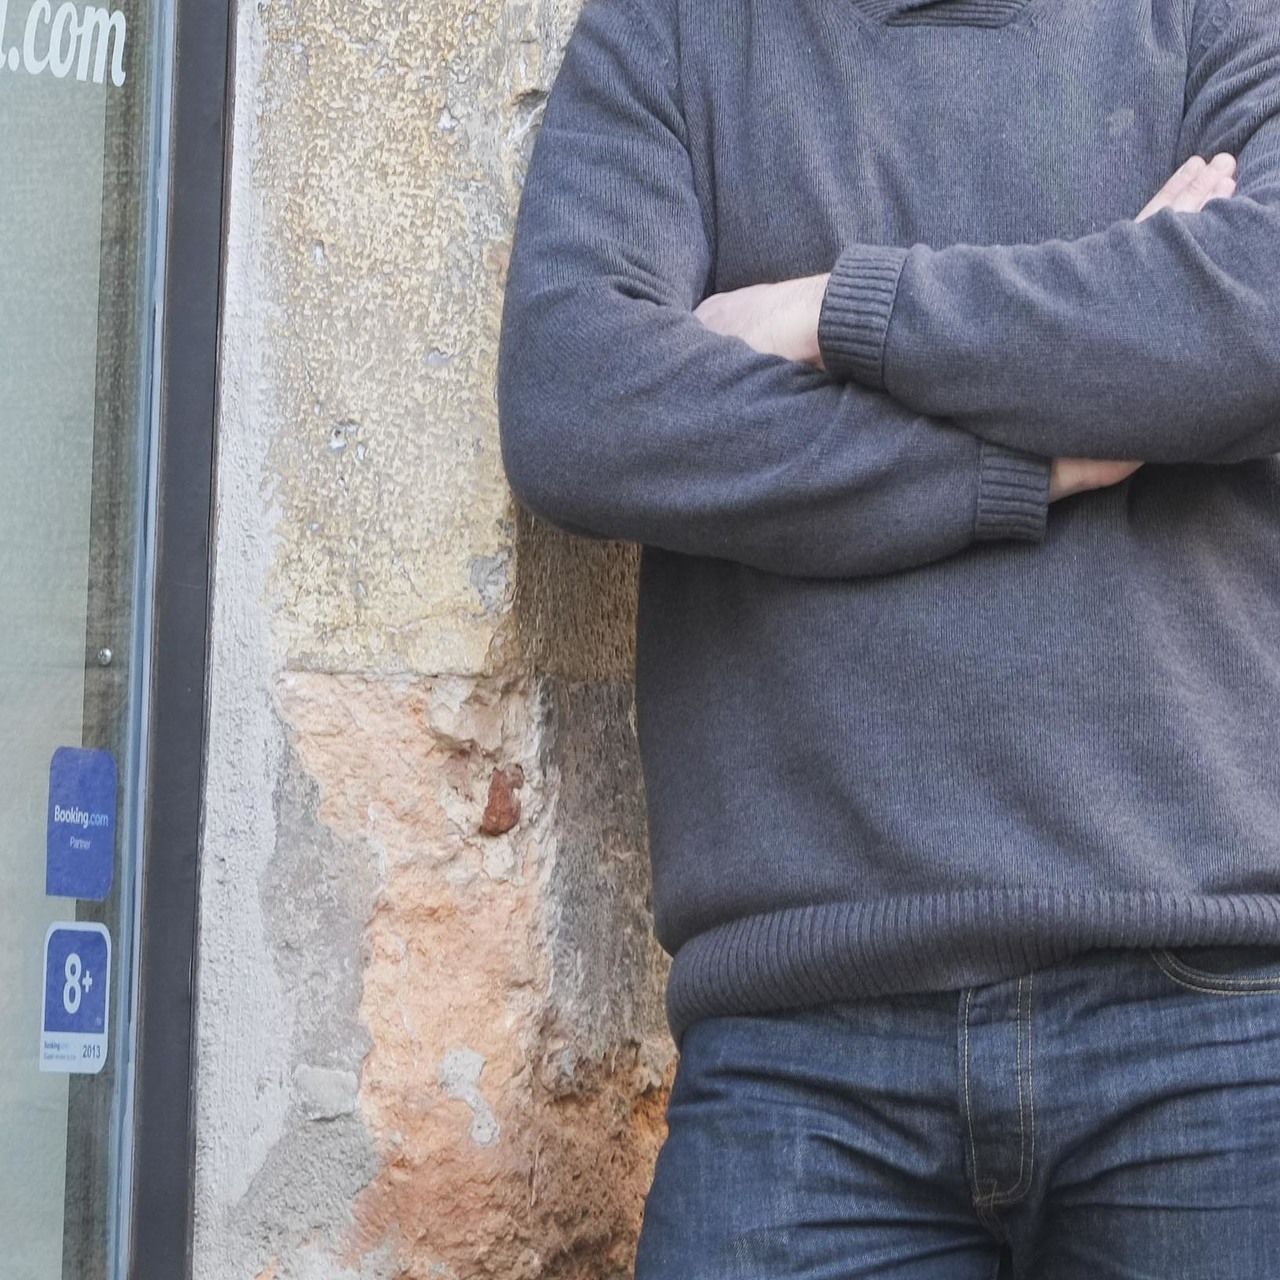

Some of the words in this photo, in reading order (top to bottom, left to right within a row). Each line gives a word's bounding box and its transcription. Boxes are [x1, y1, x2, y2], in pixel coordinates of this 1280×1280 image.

[54, 804, 109, 829] Booking.com
[70, 835, 91, 850] Partner
[82, 1044, 101, 1059] 2013
